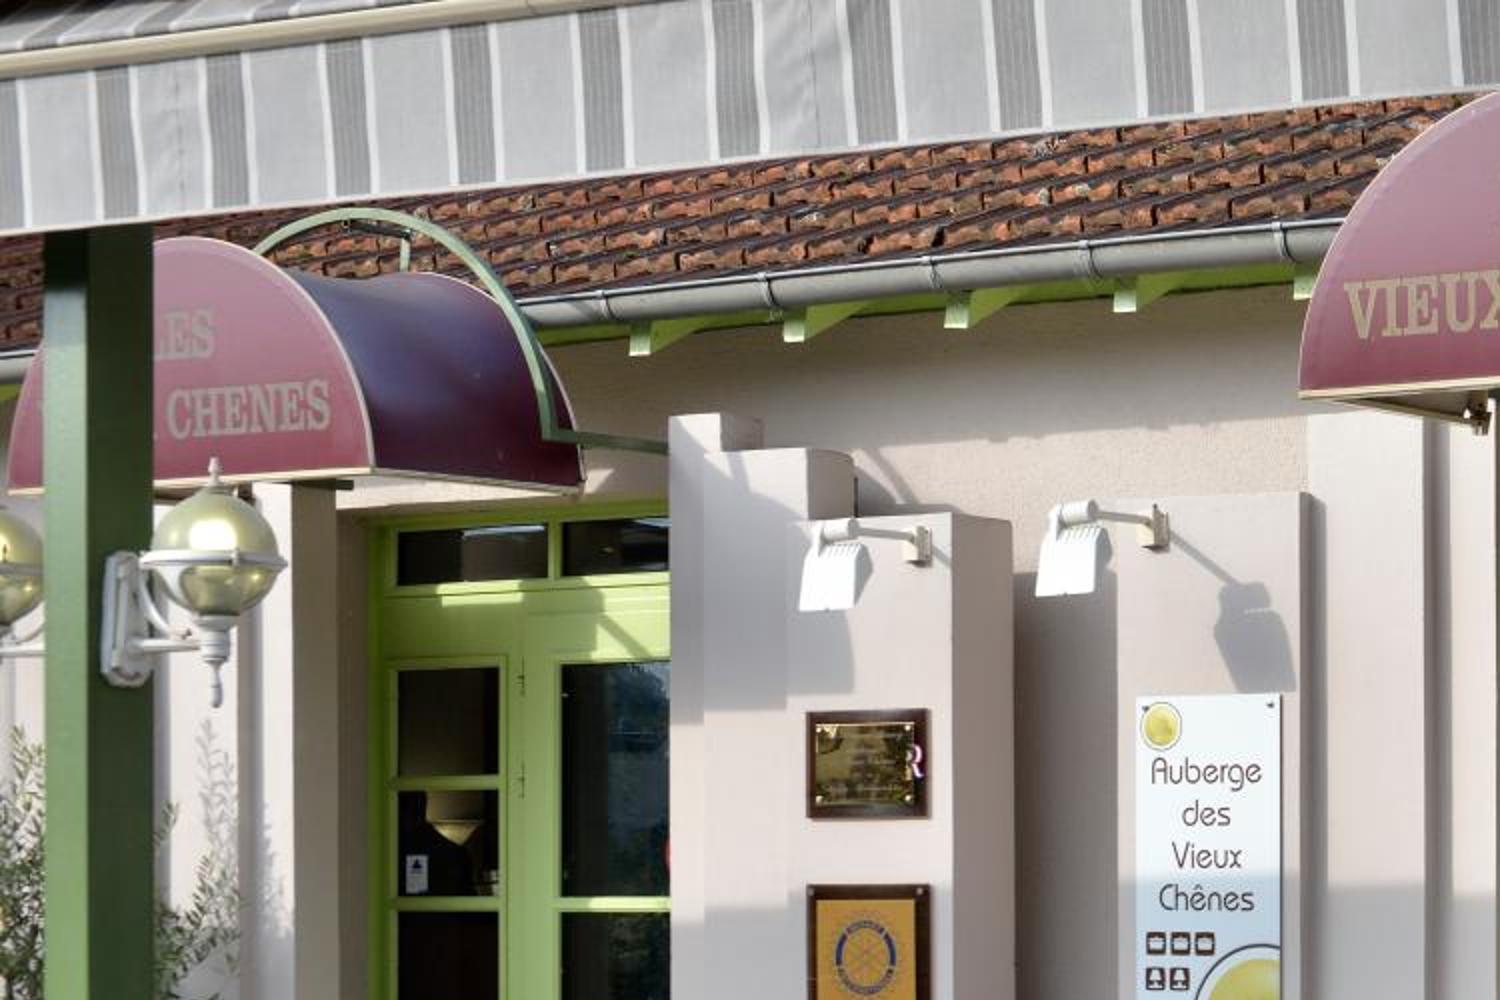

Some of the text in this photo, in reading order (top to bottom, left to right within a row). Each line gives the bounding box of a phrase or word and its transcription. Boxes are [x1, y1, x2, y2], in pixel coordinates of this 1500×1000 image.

[165, 378, 331, 441] CHENES
[1151, 757, 1263, 792] Auberge
[1182, 799, 1231, 826] des
[1171, 841, 1243, 869] Vieux
[1159, 883, 1256, 912] Chênes
